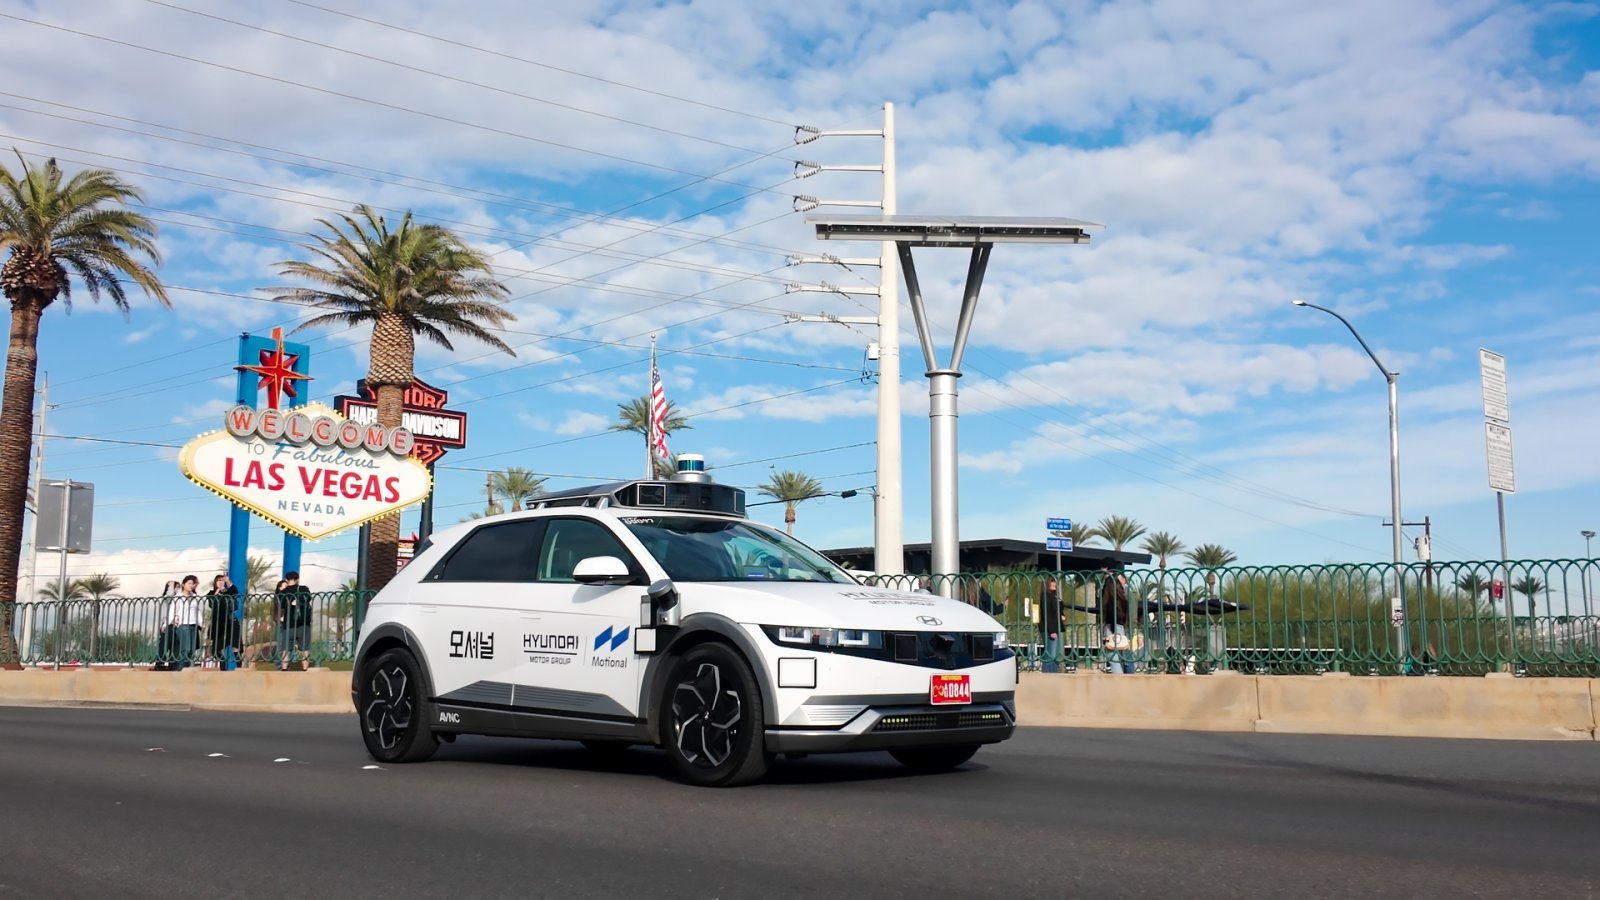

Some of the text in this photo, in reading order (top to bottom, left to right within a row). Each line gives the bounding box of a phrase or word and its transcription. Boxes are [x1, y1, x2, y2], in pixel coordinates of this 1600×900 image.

[232, 410, 407, 450] WELCOME
[247, 442, 380, 469] TO Fabulous
[224, 457, 401, 504] LAS VEGAS
[278, 500, 346, 516] NEVADA
[449, 630, 494, 660] 모셔널
[523, 633, 579, 650] HYUNDAI
[529, 655, 572, 665] MOTOR GROUP
[591, 656, 628, 669] Motional
[439, 711, 461, 724] AVNC
